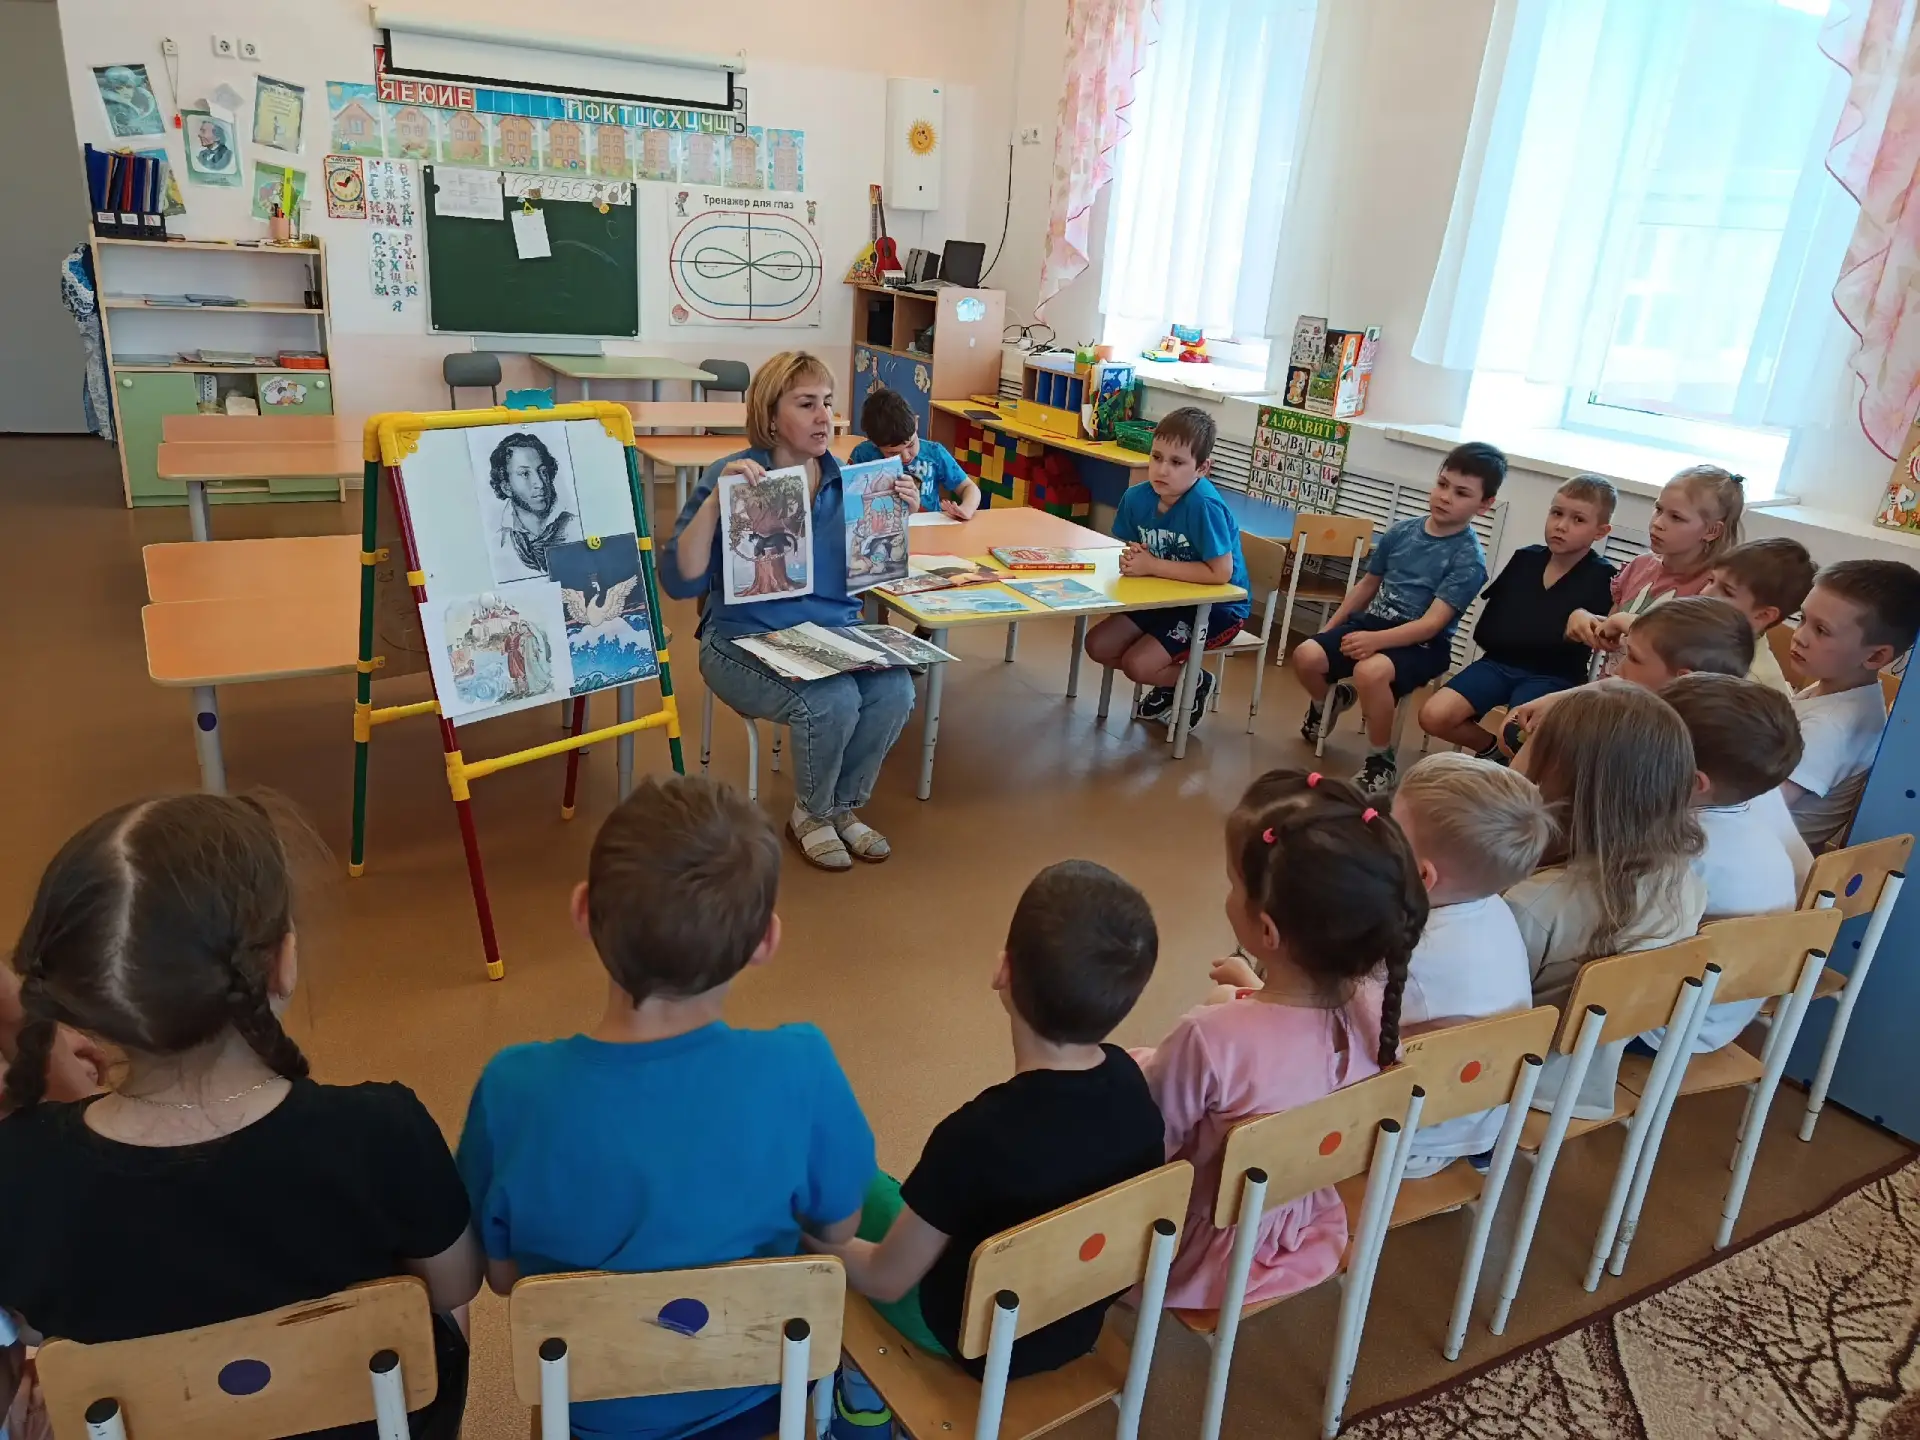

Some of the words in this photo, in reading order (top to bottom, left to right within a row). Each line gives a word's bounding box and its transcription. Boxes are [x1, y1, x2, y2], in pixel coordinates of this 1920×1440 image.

[753, 199, 772, 208] для
[774, 201, 794, 209] глаз
[1269, 413, 1333, 438] АЛФАВИТ
[1273, 432, 1282, 445] Б
[1290, 436, 1298, 449] В
[1307, 441, 1317, 453] Г
[1325, 445, 1336, 459] Д
[1286, 458, 1296, 471] Ж
[1305, 462, 1311, 475] З
[1322, 467, 1331, 480] И
[1267, 473, 1276, 487] К
[1283, 479, 1293, 491] Л
[1302, 482, 1312, 497] М
[1319, 487, 1329, 501] Н
